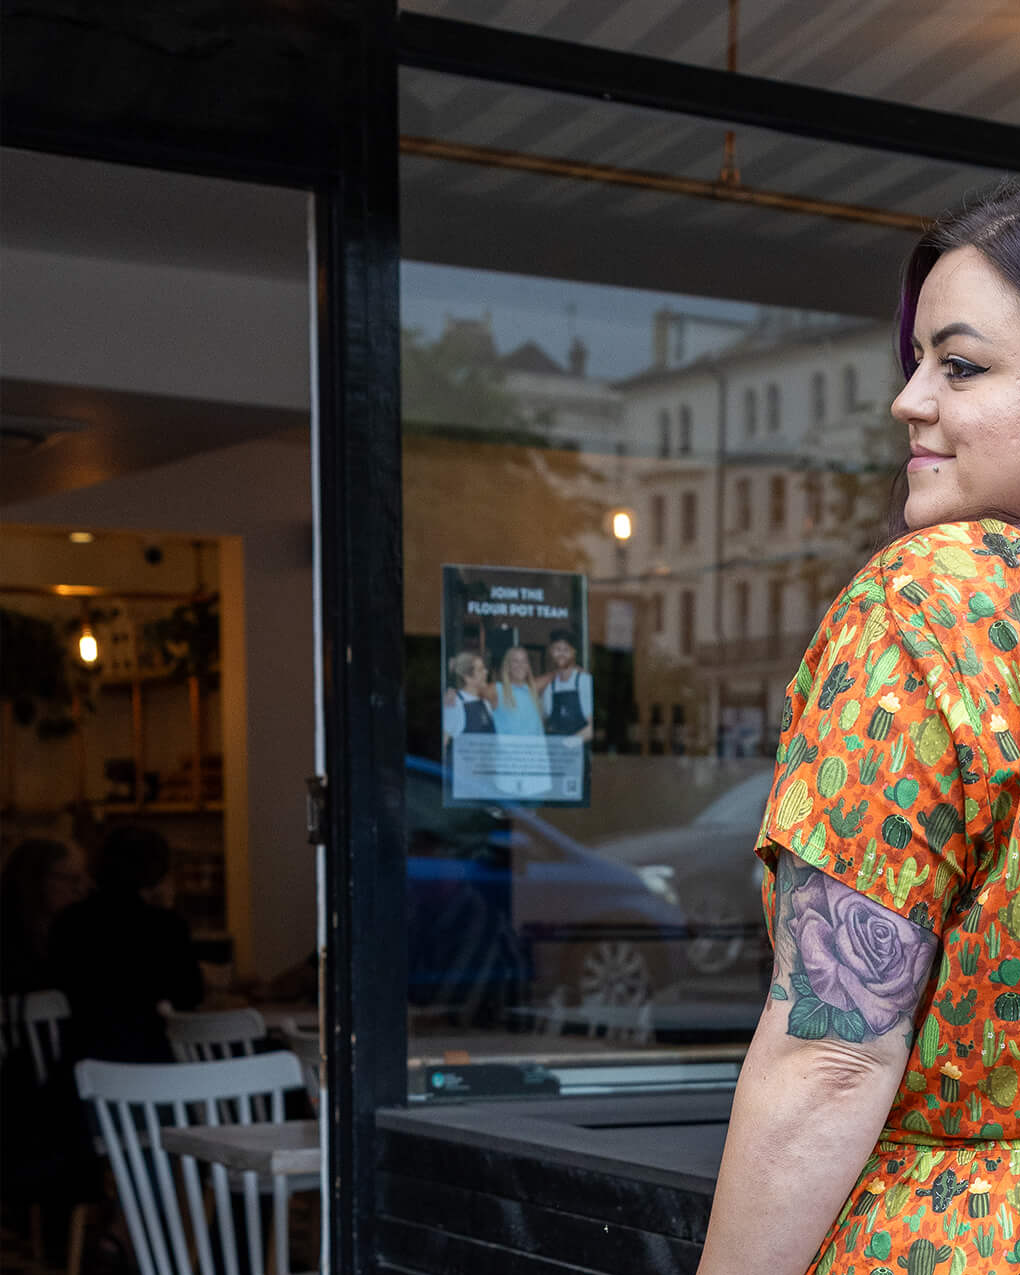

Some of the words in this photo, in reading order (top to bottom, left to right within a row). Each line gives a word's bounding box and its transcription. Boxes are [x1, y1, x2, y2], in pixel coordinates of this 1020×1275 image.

[490, 586, 519, 600] JOIN
[520, 587, 545, 602] THE
[467, 601, 508, 616] FLOUR
[509, 603, 535, 617] POT
[536, 604, 569, 619] TEAM
